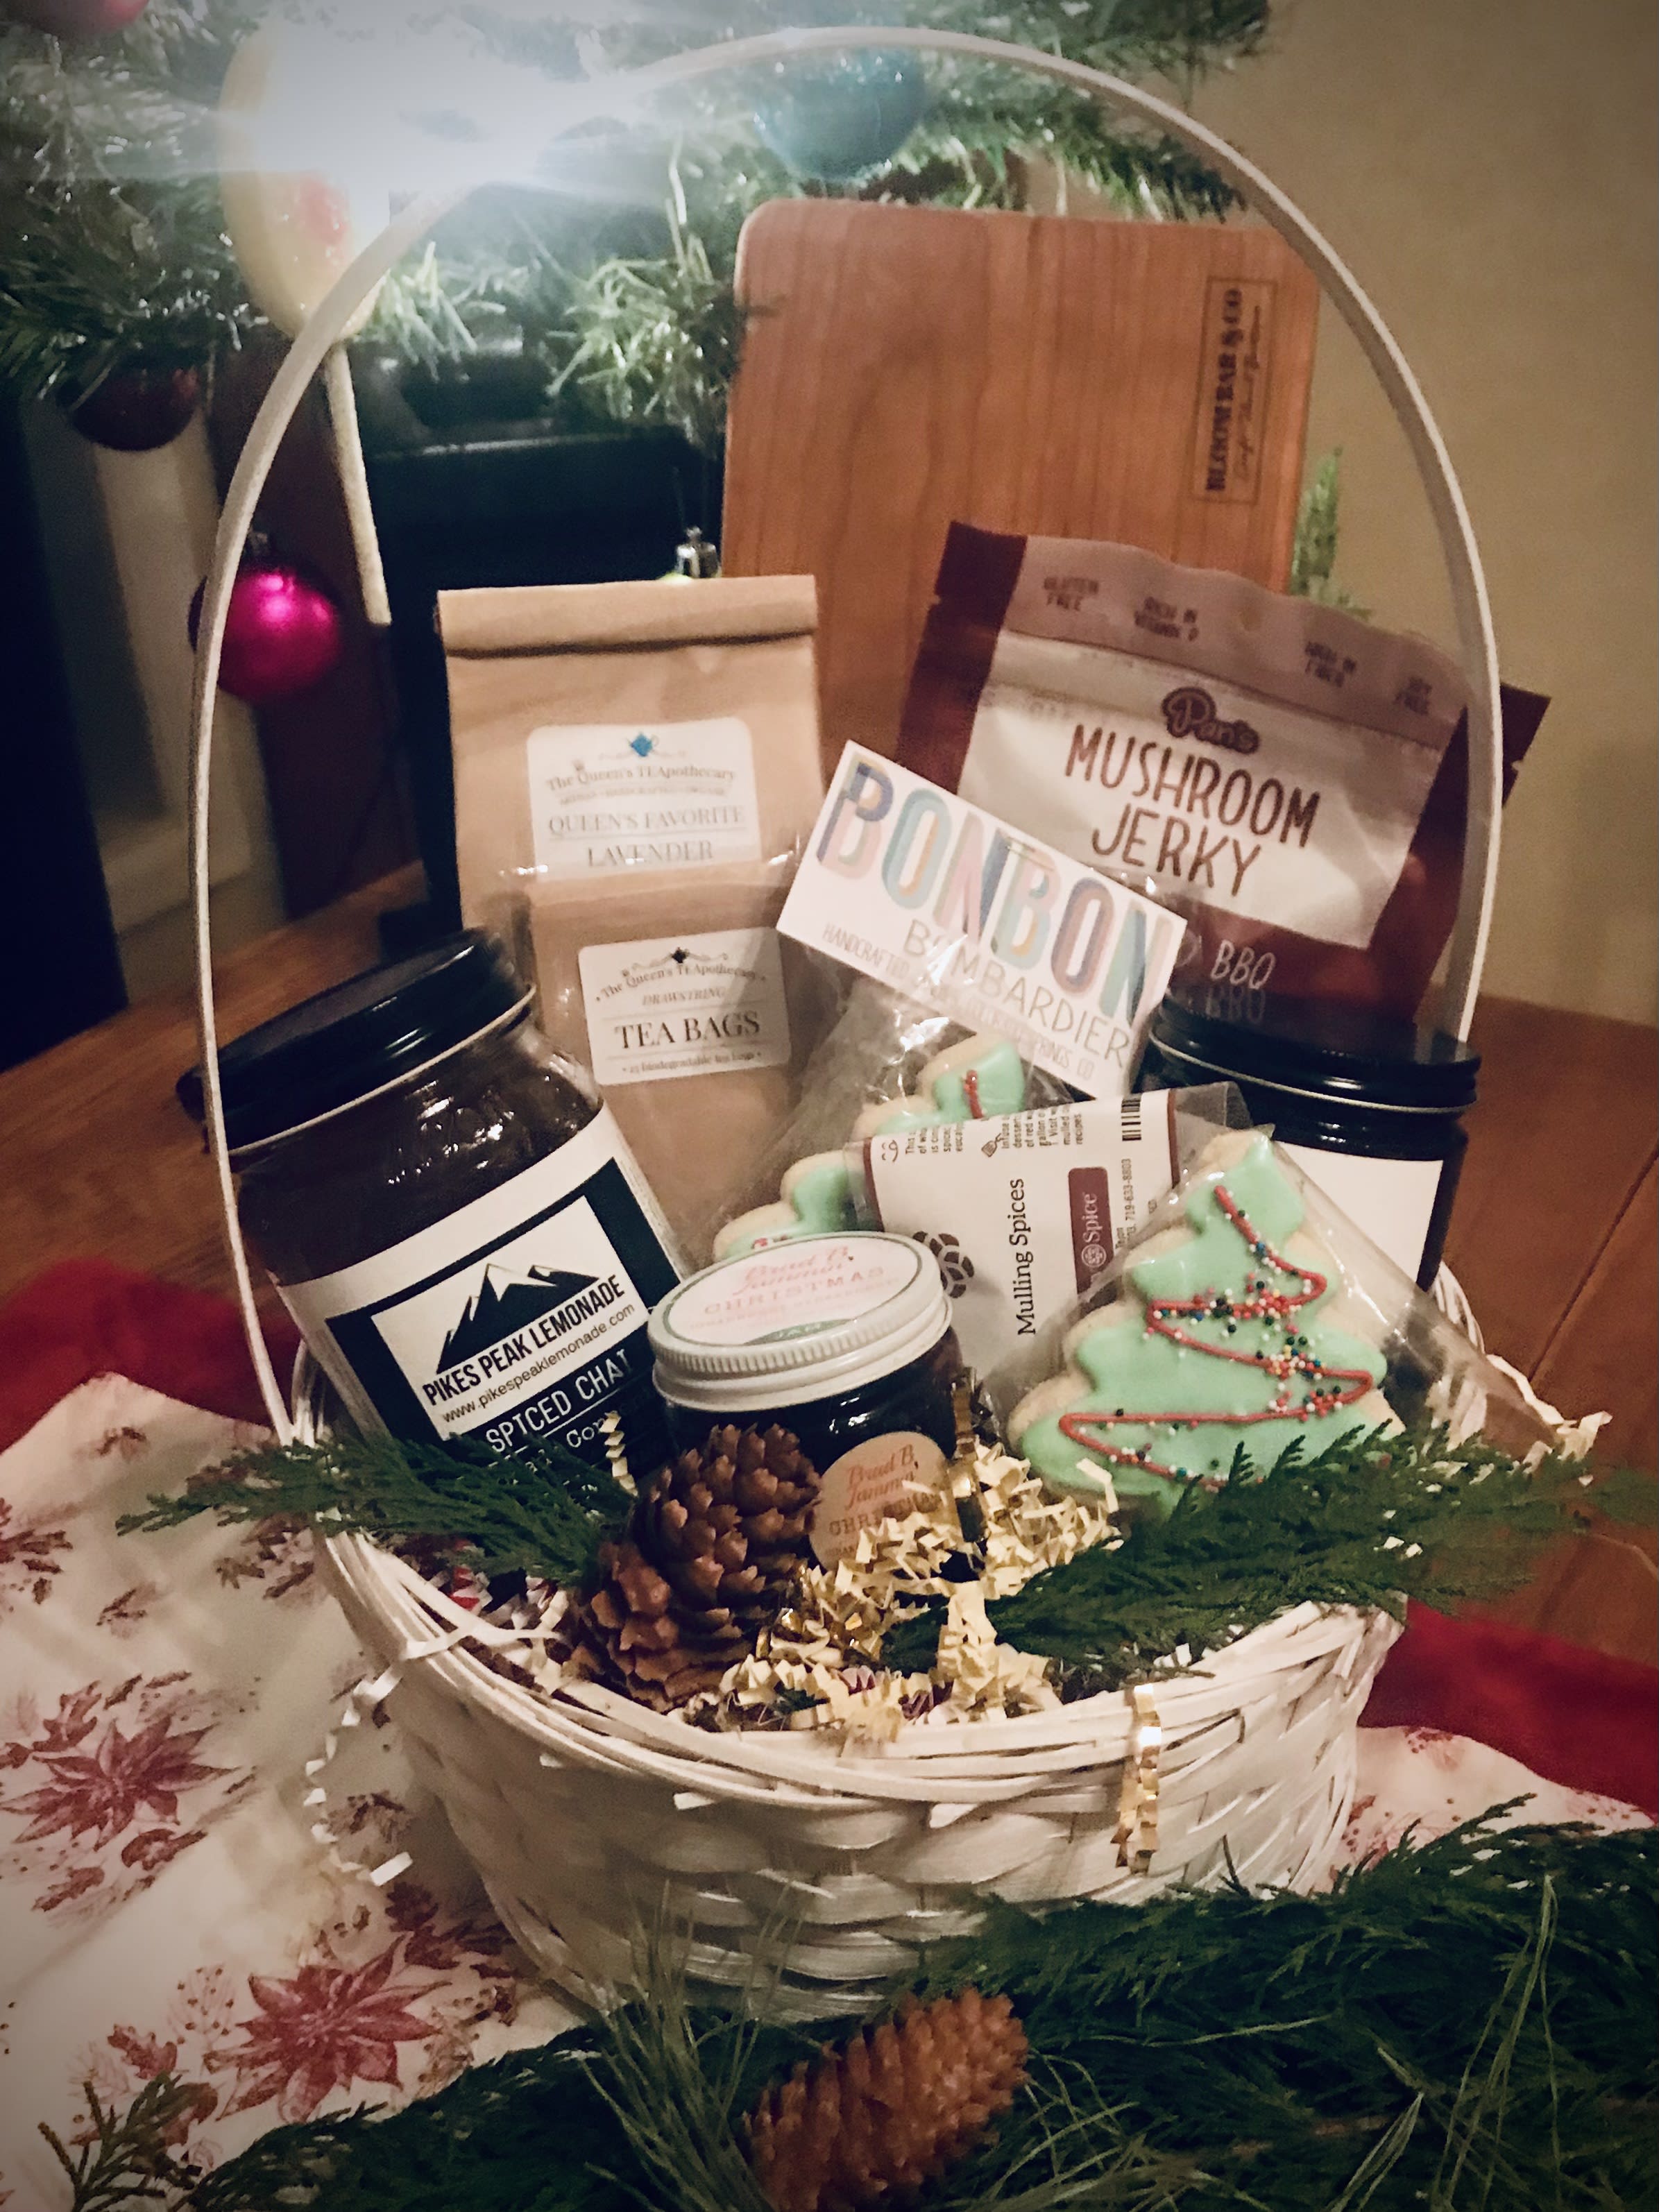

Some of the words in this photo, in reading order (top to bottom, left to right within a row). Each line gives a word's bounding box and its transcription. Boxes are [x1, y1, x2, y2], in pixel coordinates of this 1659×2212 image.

[1064, 722, 1322, 849] MUSHROOM
[548, 810, 639, 835] QUEEN'S
[645, 804, 746, 829] FAVORITE
[588, 840, 714, 867] LAVENDER
[1090, 803, 1263, 899] JERKY
[816, 751, 1174, 1028] BONBON
[600, 982, 623, 999] The
[625, 967, 673, 989] Queen's
[1210, 939, 1277, 990] BBQ
[643, 987, 726, 1005] DRAWSTRING
[615, 1021, 676, 1049] TEA
[683, 1010, 760, 1042] BAGS
[1007, 1177, 1032, 1247] Spices
[1082, 1192, 1103, 1243] Spice
[704, 1266, 885, 1315] CHRISTMAS
[1012, 1250, 1037, 1336] Mulling
[422, 1363, 482, 1406] PIKES
[477, 1333, 533, 1379] PEAK
[529, 1274, 625, 1350] LEMONADE
[442, 1302, 636, 1423] www.pikespeaklemonade.com
[486, 1390, 572, 1453] SPICED
